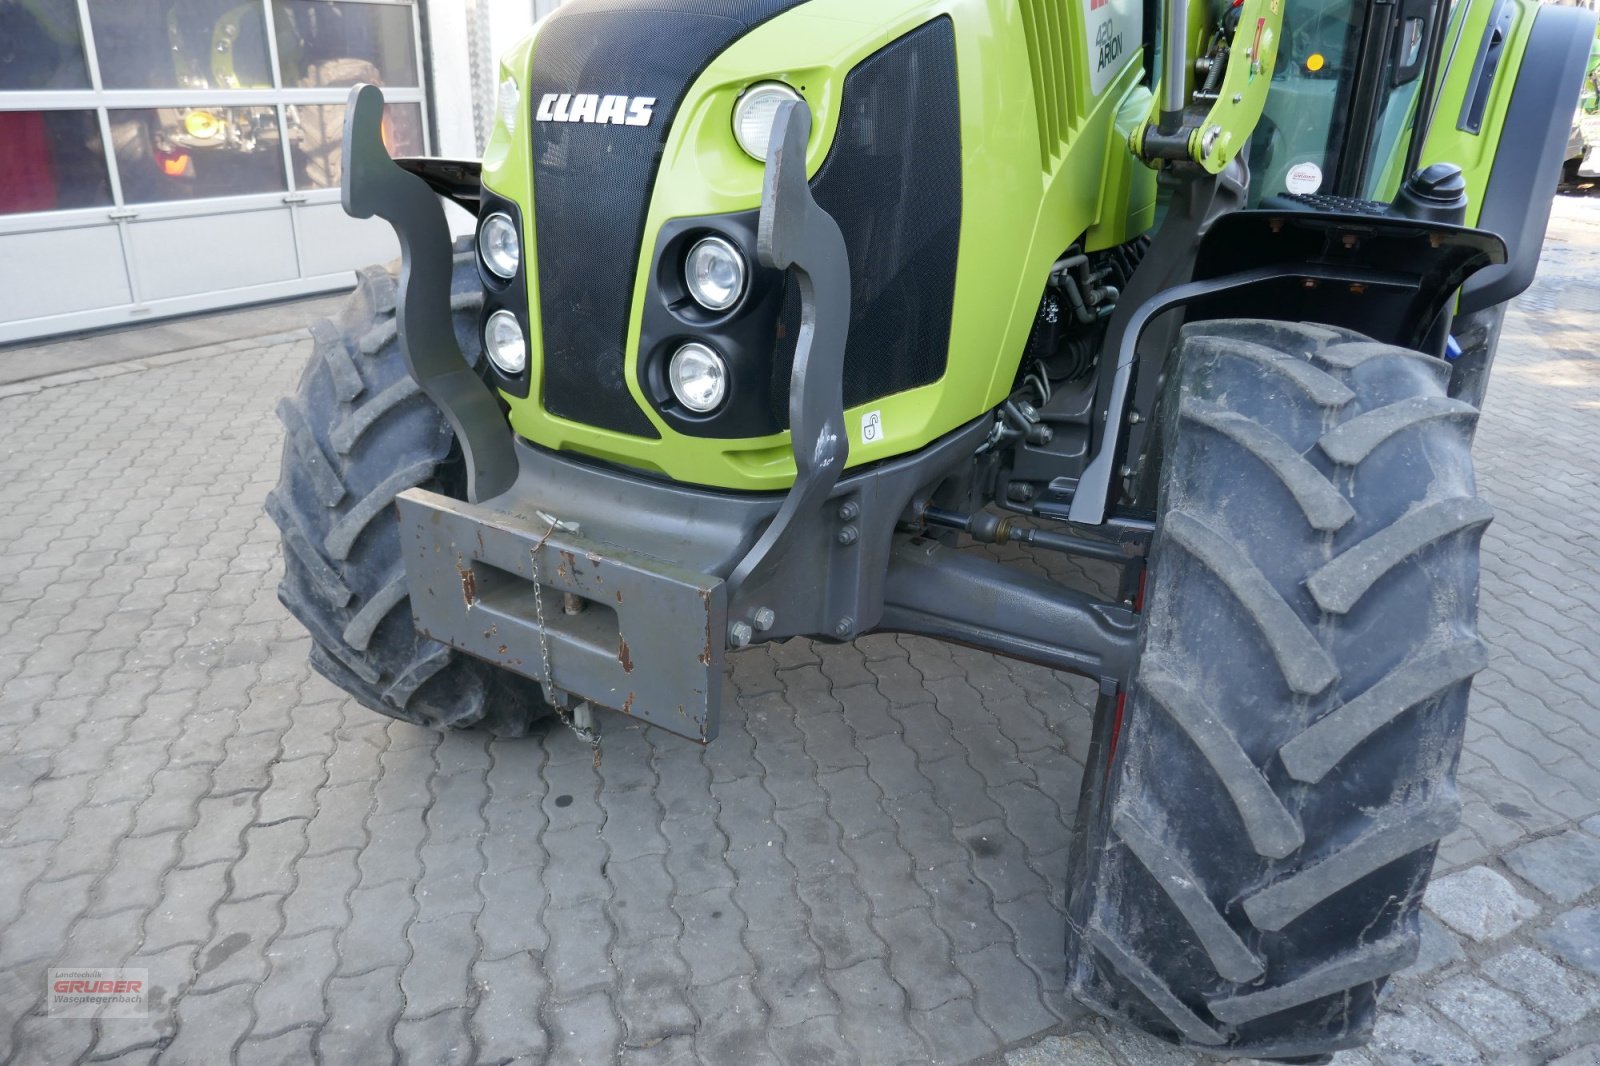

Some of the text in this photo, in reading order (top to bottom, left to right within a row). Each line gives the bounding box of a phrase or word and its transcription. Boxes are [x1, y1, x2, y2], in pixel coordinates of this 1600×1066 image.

[1095, 18, 1113, 47] 420
[1097, 32, 1123, 73] ARION
[535, 93, 657, 127] CLAAS
